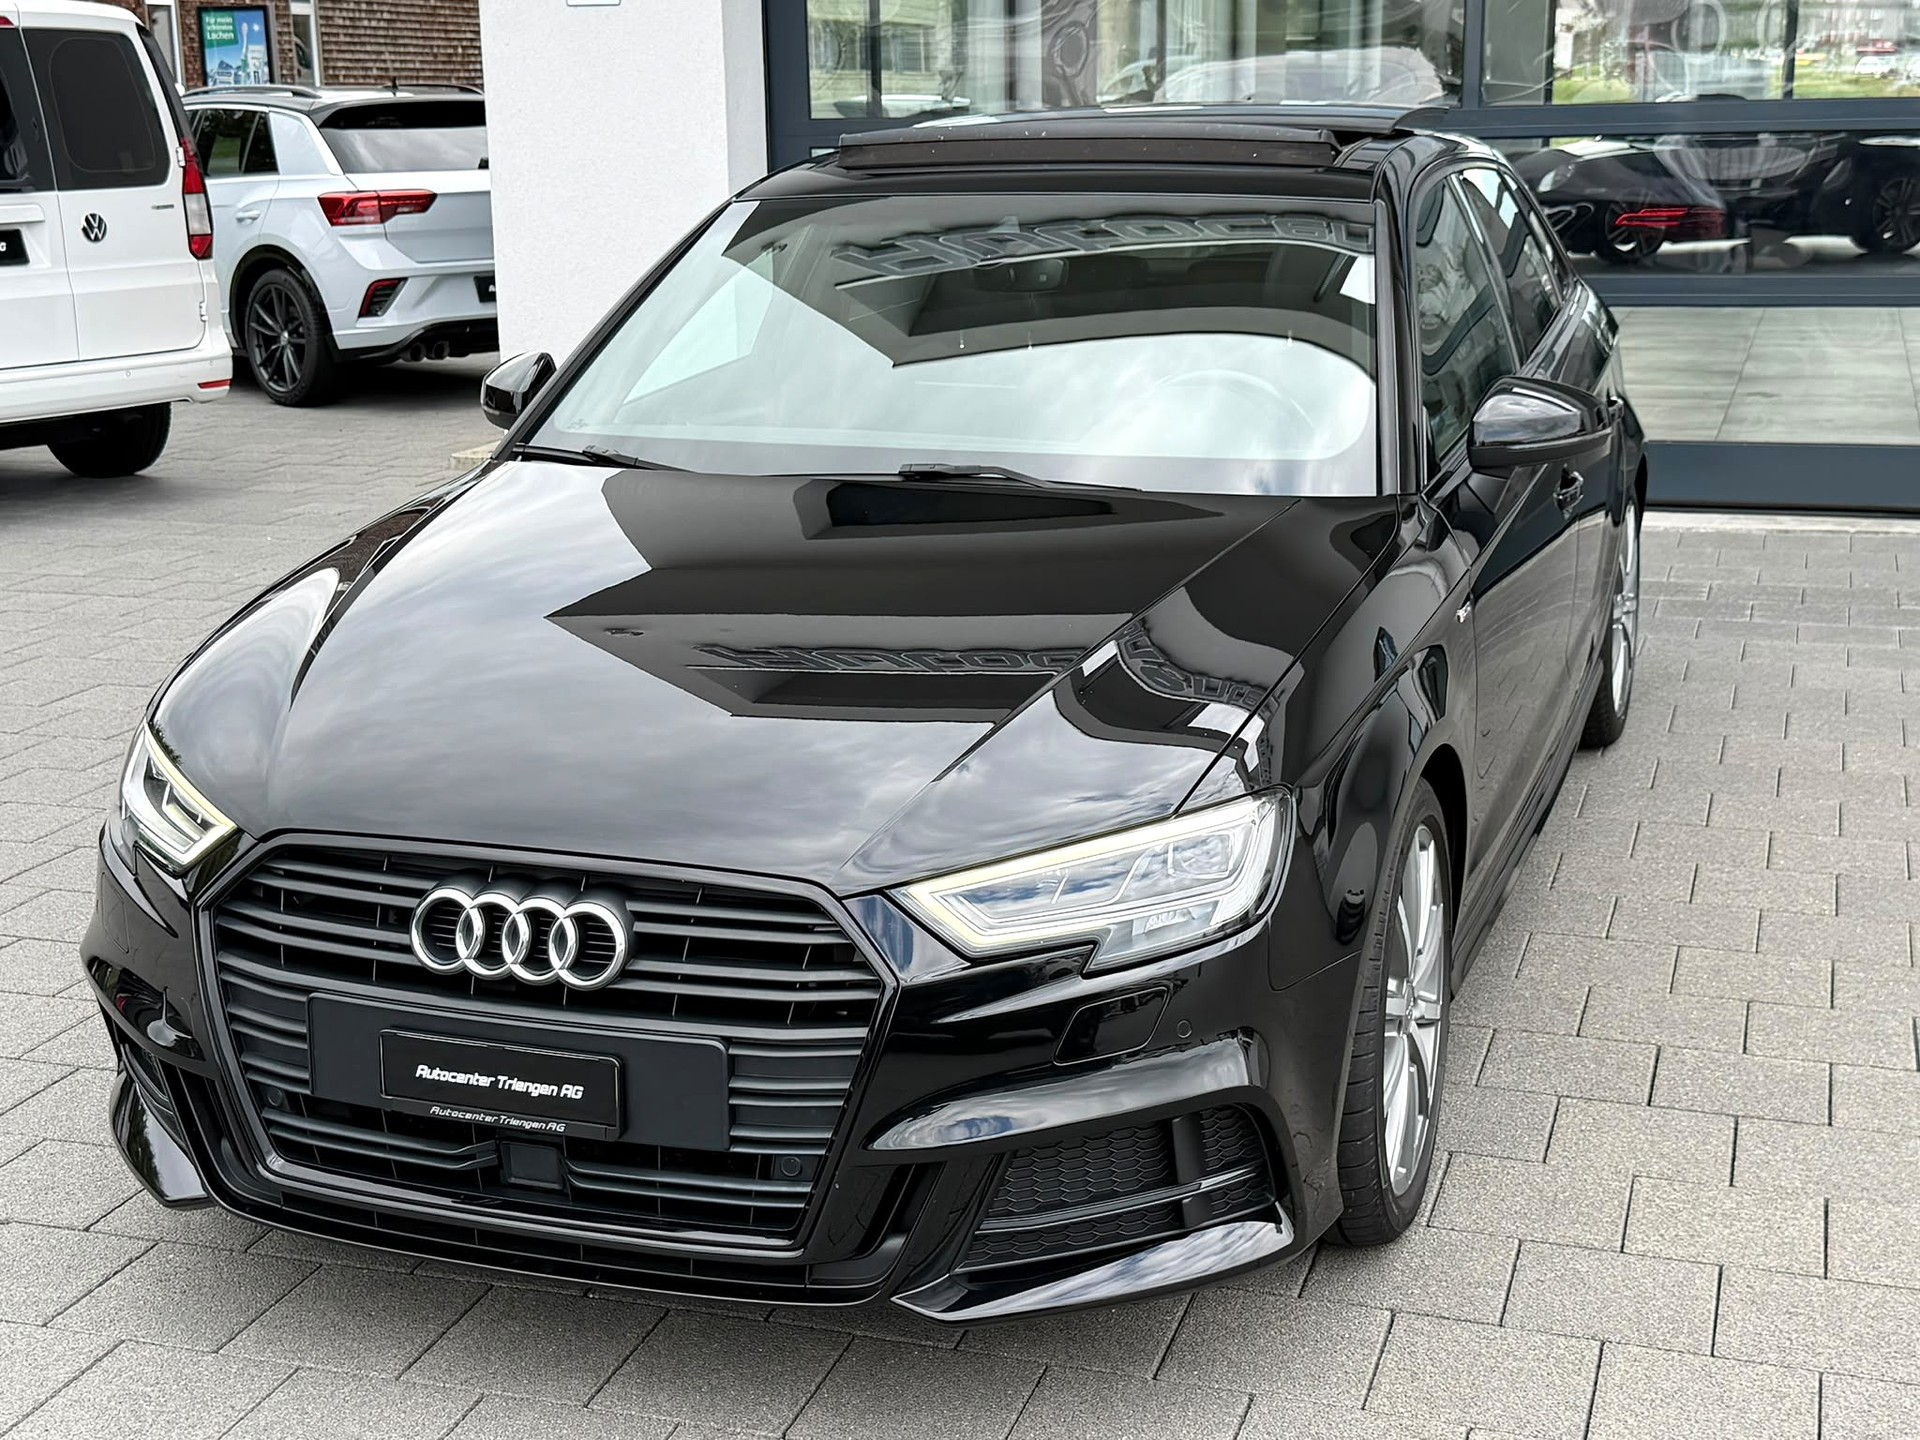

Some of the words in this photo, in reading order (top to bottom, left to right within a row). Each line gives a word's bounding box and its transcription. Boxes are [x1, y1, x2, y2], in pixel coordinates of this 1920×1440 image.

[207, 31, 234, 40] Lachen
[415, 1064, 496, 1088] Autocenter
[497, 1075, 558, 1097] Triengen
[560, 1084, 584, 1100] AG
[429, 1105, 500, 1124] Autocenter
[499, 1115, 547, 1131] Triengen
[546, 1121, 566, 1133] AG
